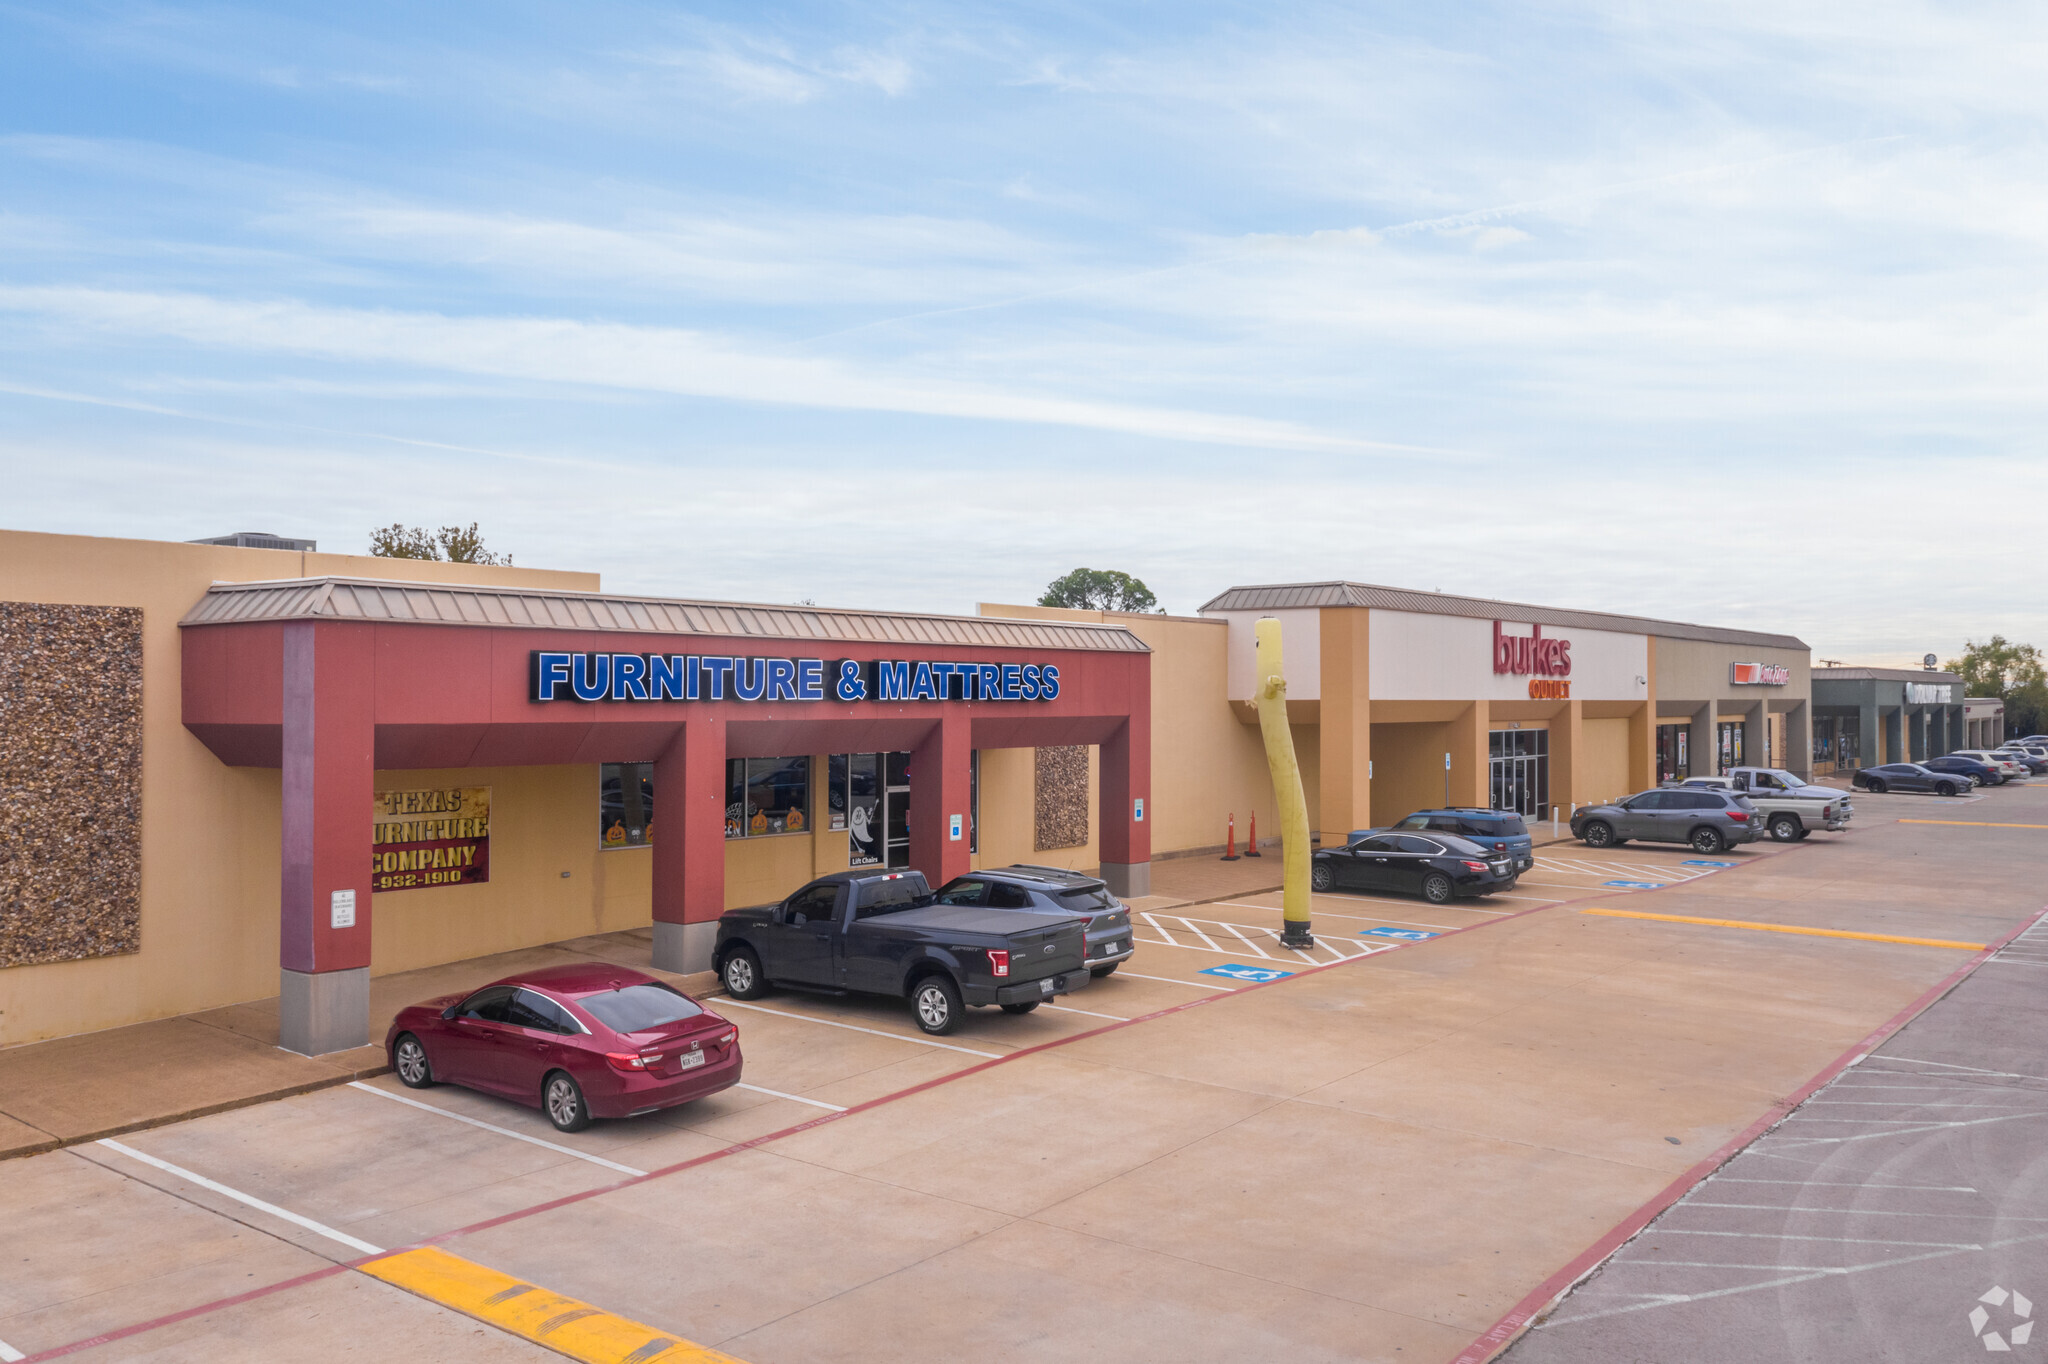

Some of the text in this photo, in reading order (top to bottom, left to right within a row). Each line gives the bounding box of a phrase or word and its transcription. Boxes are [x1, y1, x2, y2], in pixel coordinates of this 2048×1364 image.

[1493, 620, 1571, 676] burkes
[538, 652, 1060, 701] FURNITURE & MATTRESS
[1528, 679, 1571, 699] OUTLET
[384, 790, 461, 815] TEXAS
[372, 817, 489, 845] URNITURE
[372, 845, 477, 874] COMPANY
[852, 856, 879, 865] Lift Chairs
